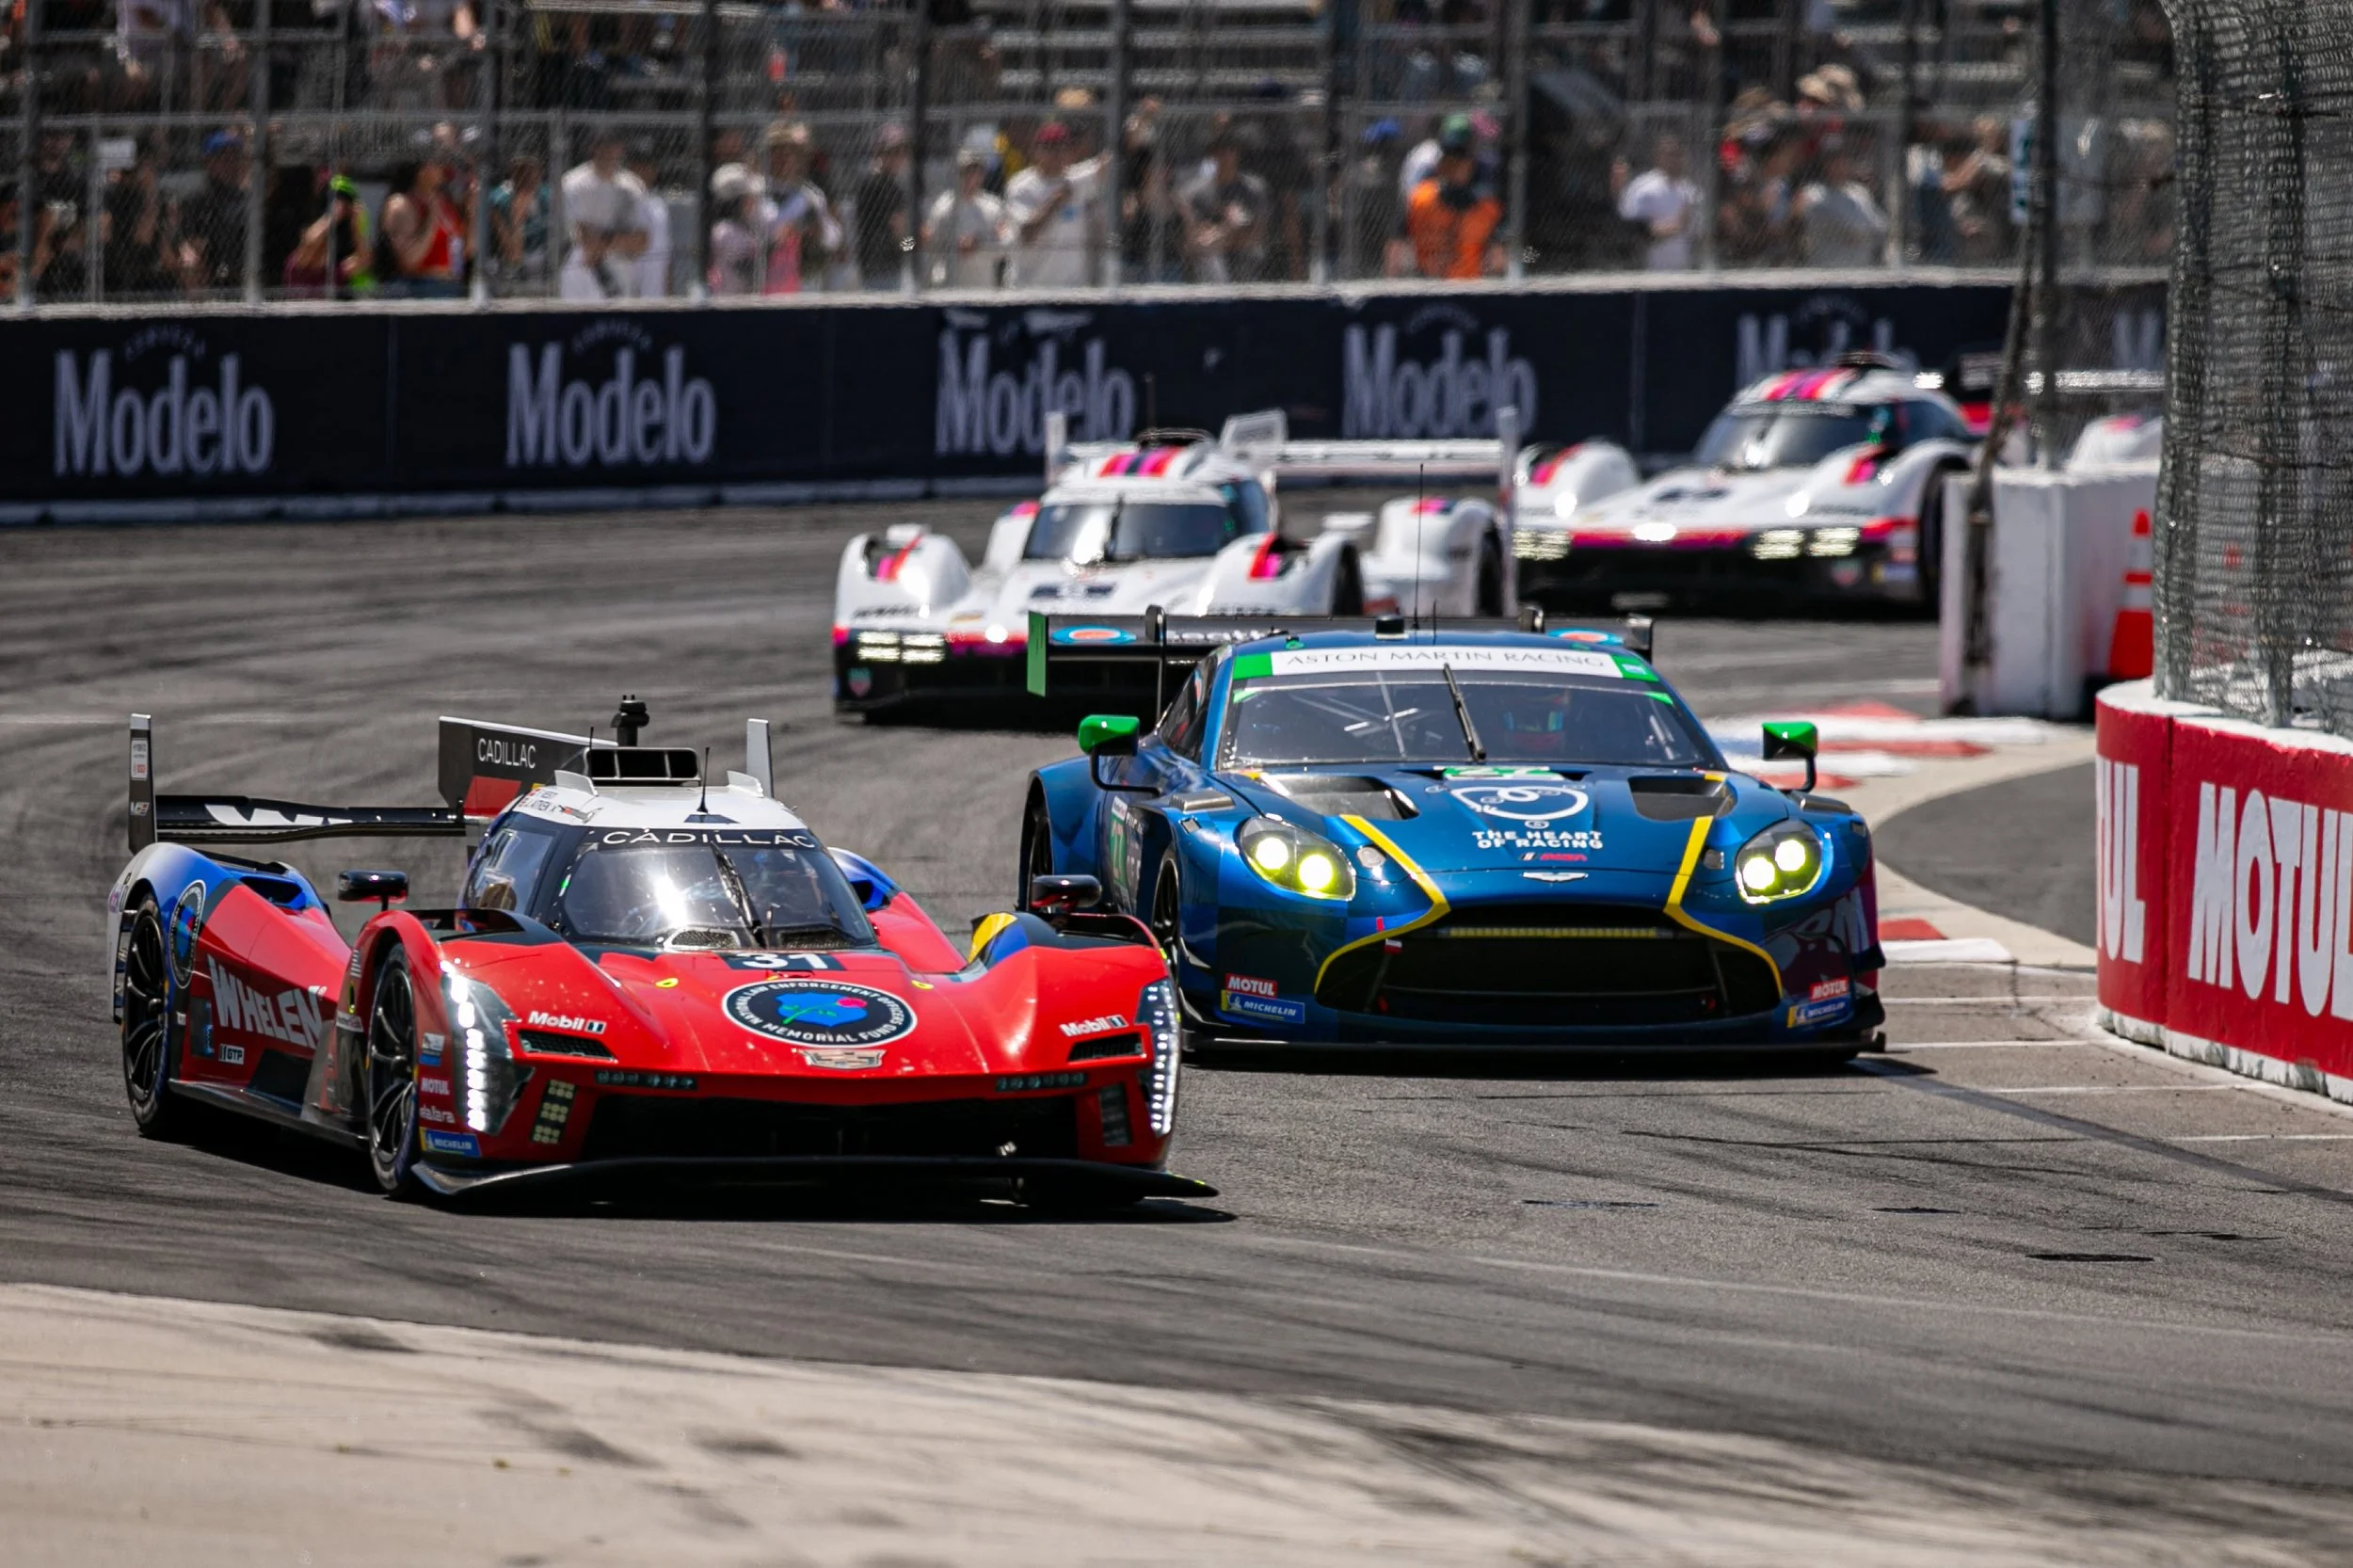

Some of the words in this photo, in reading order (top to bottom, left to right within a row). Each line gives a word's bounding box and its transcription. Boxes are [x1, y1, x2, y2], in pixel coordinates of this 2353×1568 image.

[935, 329, 1137, 456] Modelo
[1341, 325, 1538, 440] Modelo
[54, 348, 275, 476] Modelo
[506, 341, 717, 467] Modelo
[1288, 652, 1378, 665] ASTON
[1390, 651, 1493, 662] MARTIN
[1506, 653, 1605, 667] RACING
[477, 738, 536, 770] CADILLAC
[602, 829, 816, 849] CADILLAC
[1472, 830, 1518, 840] THE
[1526, 830, 1602, 840] HEART
[1477, 840, 1506, 849] OF
[1516, 839, 1604, 850] RACING
[2187, 780, 2353, 1022] MOTUL
[736, 952, 828, 968] 31
[768, 982, 879, 998] ENFORCEMENT
[1227, 976, 1275, 997] MOTUL
[1813, 980, 1849, 1000] MOTUL
[207, 953, 322, 1051] WHELEN
[1243, 1000, 1297, 1017] MICHELIN
[528, 1010, 585, 1032] Mobil
[1059, 1016, 1112, 1037] Mobil
[762, 1022, 858, 1043] MEMORIAL
[858, 1022, 897, 1041] FUND
[227, 1048, 244, 1061] GTP
[421, 1077, 451, 1096] MOTUL
[433, 1137, 472, 1150] MICHELIN
